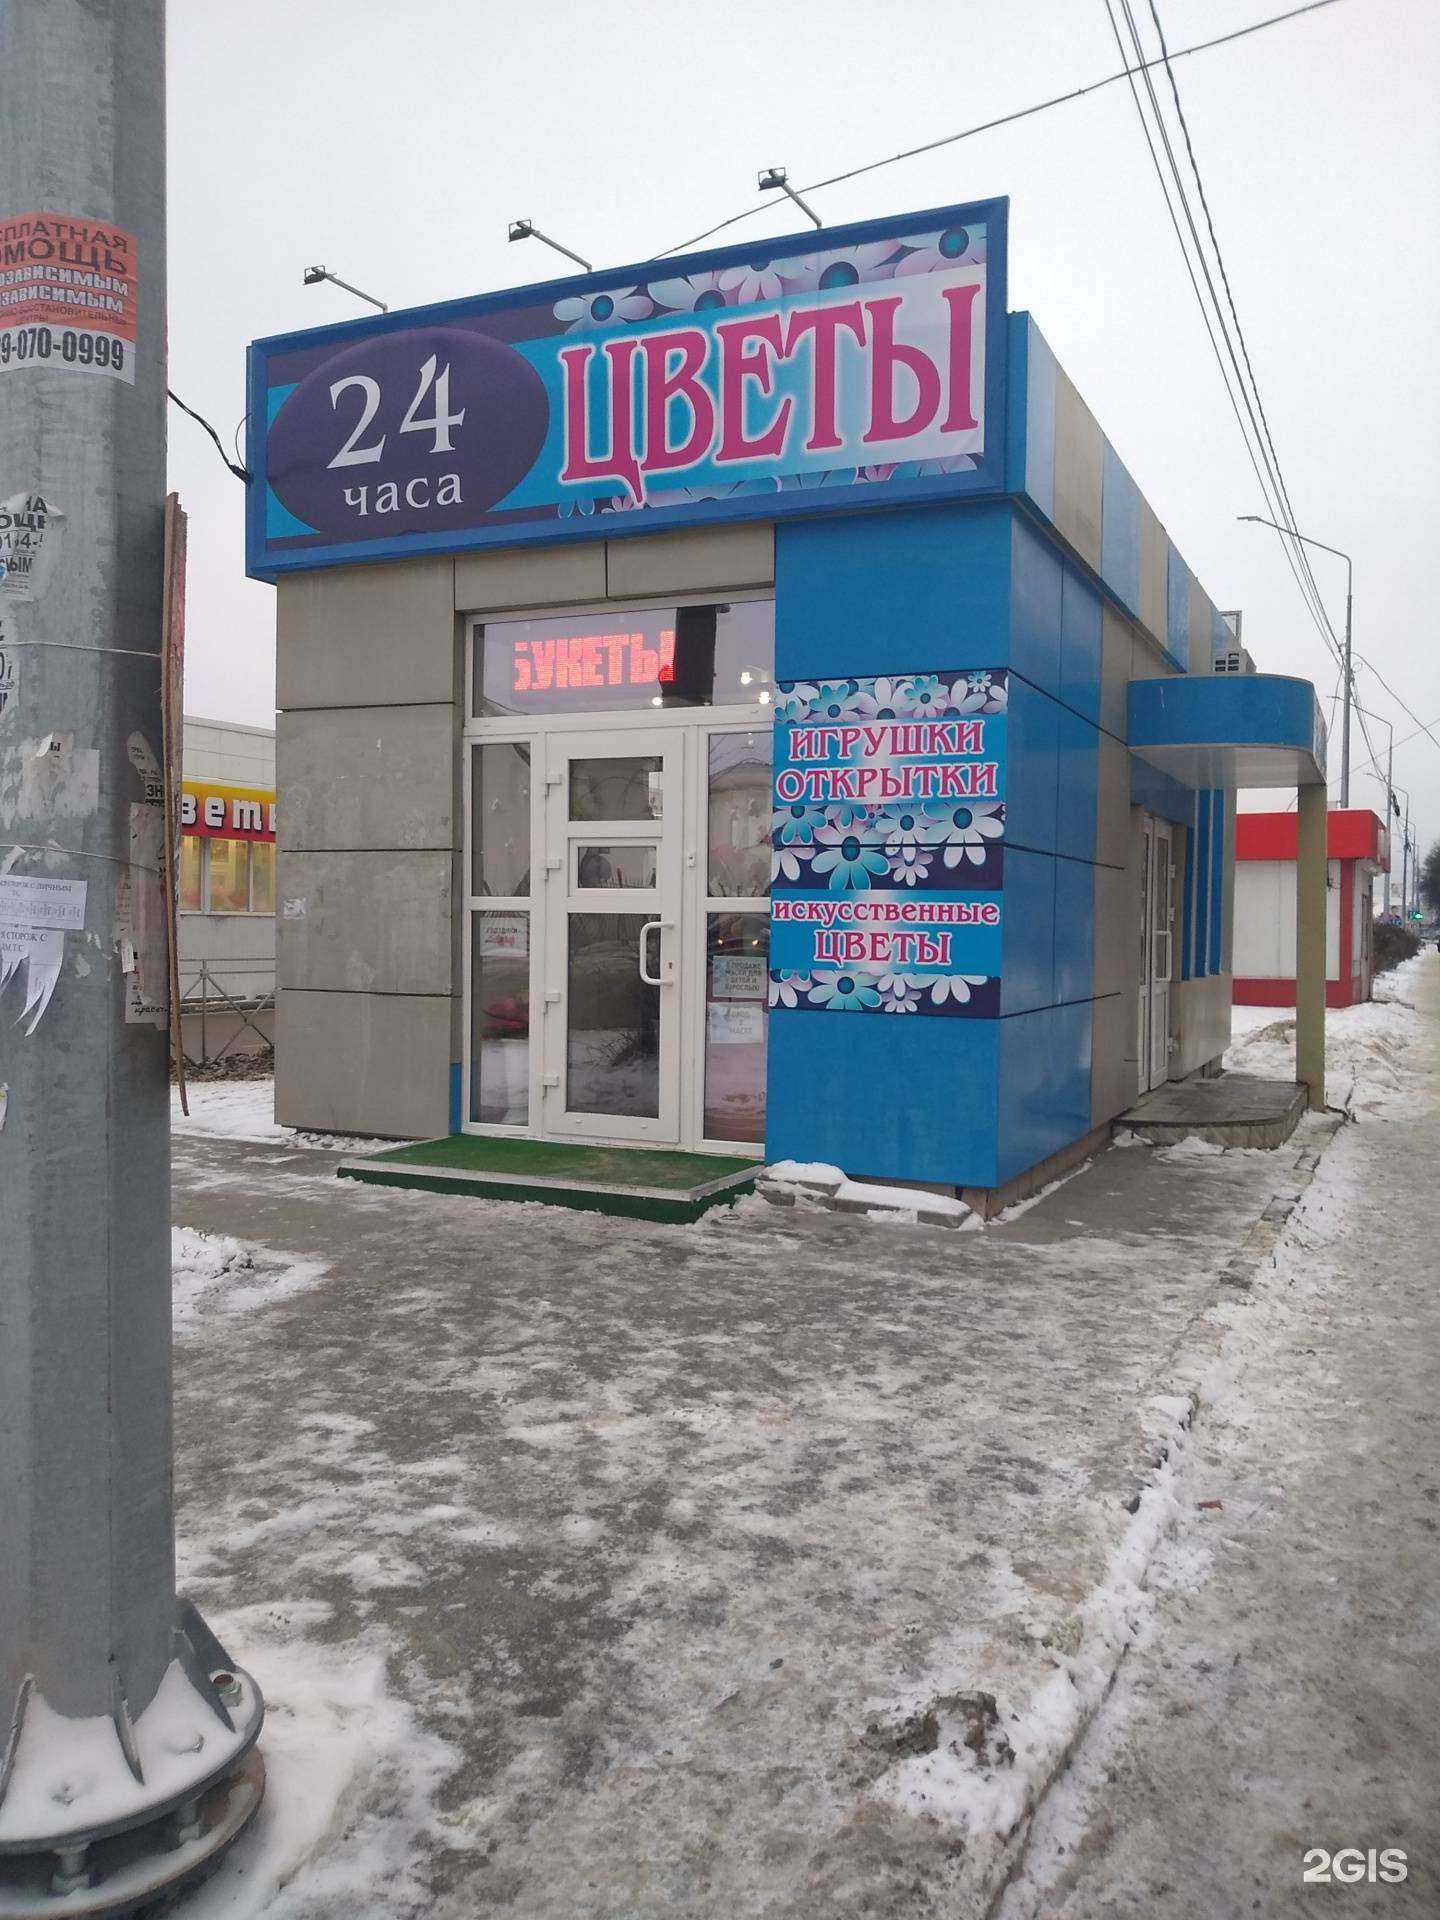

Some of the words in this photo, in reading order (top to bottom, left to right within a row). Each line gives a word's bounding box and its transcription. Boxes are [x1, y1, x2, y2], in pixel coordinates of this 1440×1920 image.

[0, 220, 128, 253] ПЛАТНАЯ
[0, 238, 128, 274] МОЩЬ
[0, 327, 124, 371] 9-070-0999
[328, 353, 466, 470] 24
[558, 284, 983, 504] ЦВЕТЫ
[343, 473, 464, 517] часа
[789, 720, 985, 761] ИГРУШКИ
[777, 763, 998, 801] ОТКРЫТКИ
[773, 900, 999, 925] искусственные
[814, 930, 952, 966] ЦВЕТЫ
